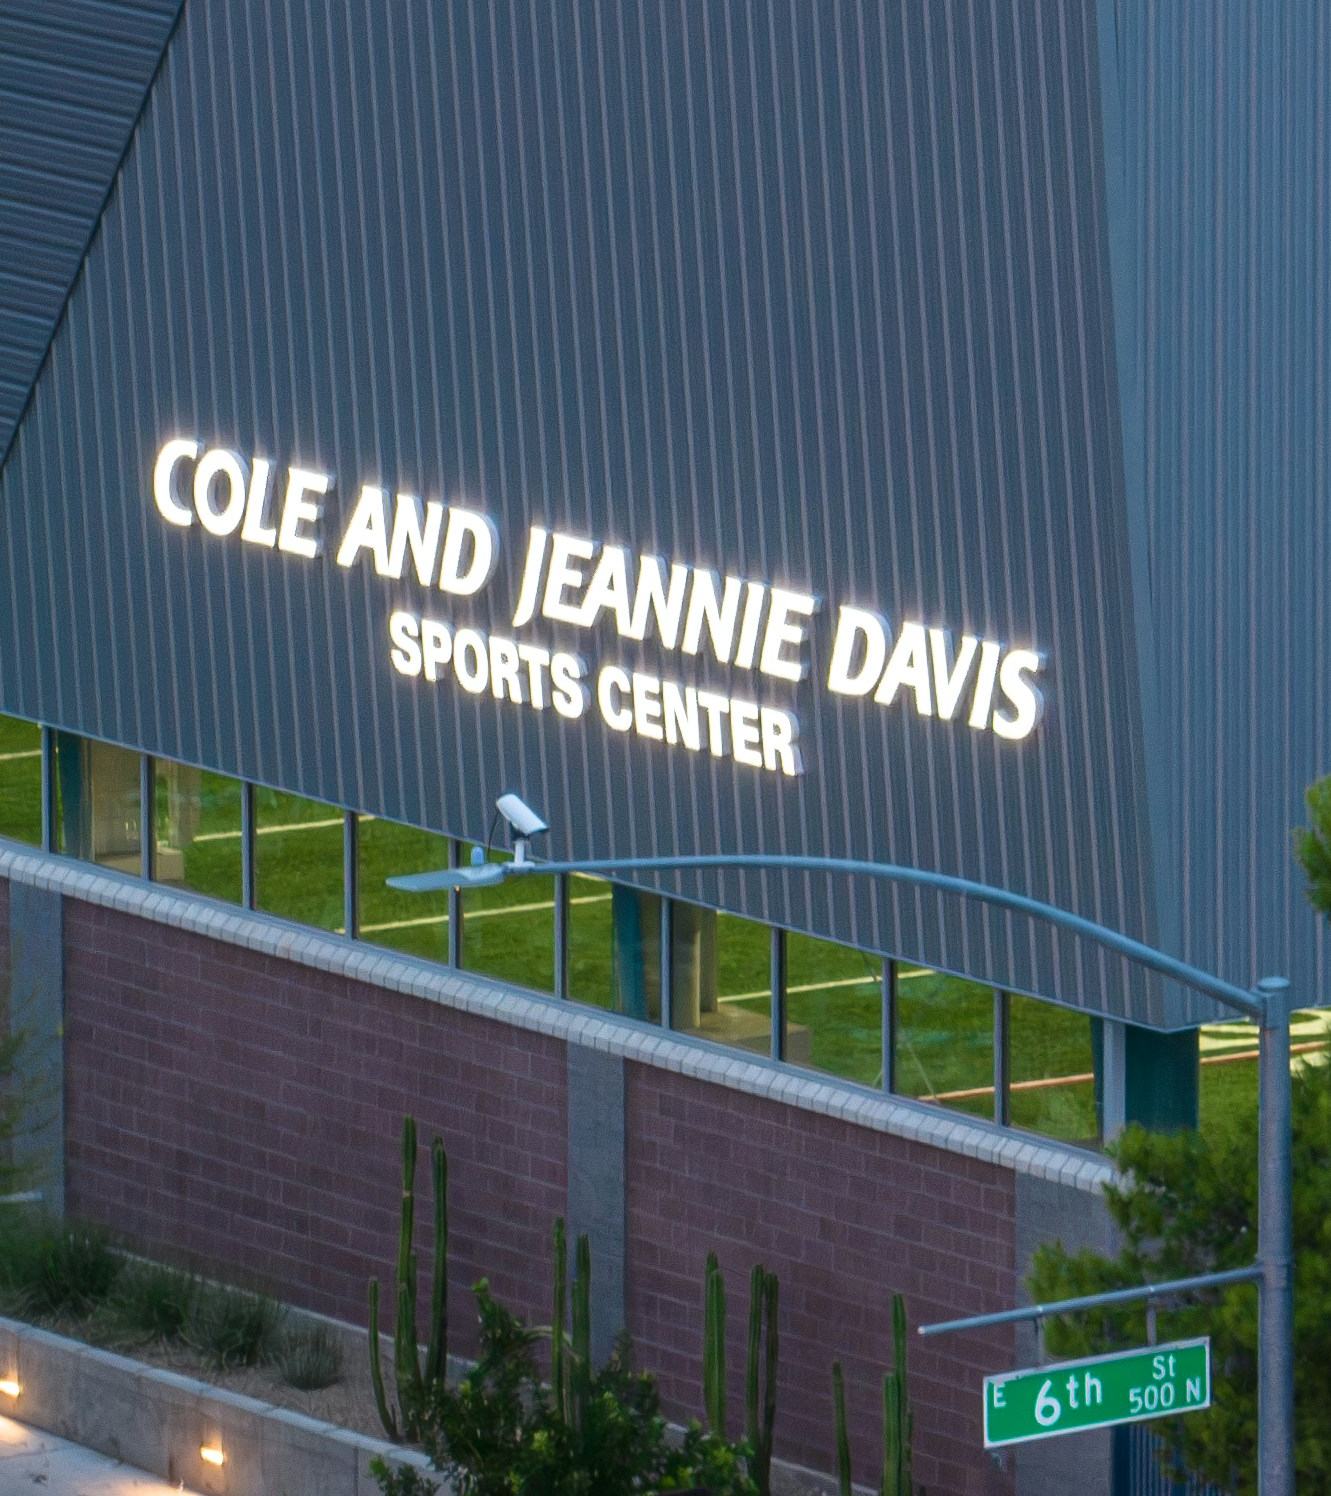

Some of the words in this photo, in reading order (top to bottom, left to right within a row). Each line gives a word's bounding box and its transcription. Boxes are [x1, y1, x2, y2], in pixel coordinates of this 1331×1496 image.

[153, 437, 334, 559] COLE
[337, 484, 498, 596] AND
[512, 526, 816, 682] JEANNIE
[827, 605, 1045, 741] DAVIS
[389, 611, 588, 718] SPORTS
[598, 665, 801, 775] CENTER
[993, 1383, 1006, 1407] E
[1035, 1372, 1102, 1426] 6th
[1153, 1354, 1177, 1380] St
[1130, 1382, 1174, 1413] 500
[1186, 1376, 1201, 1402] N
